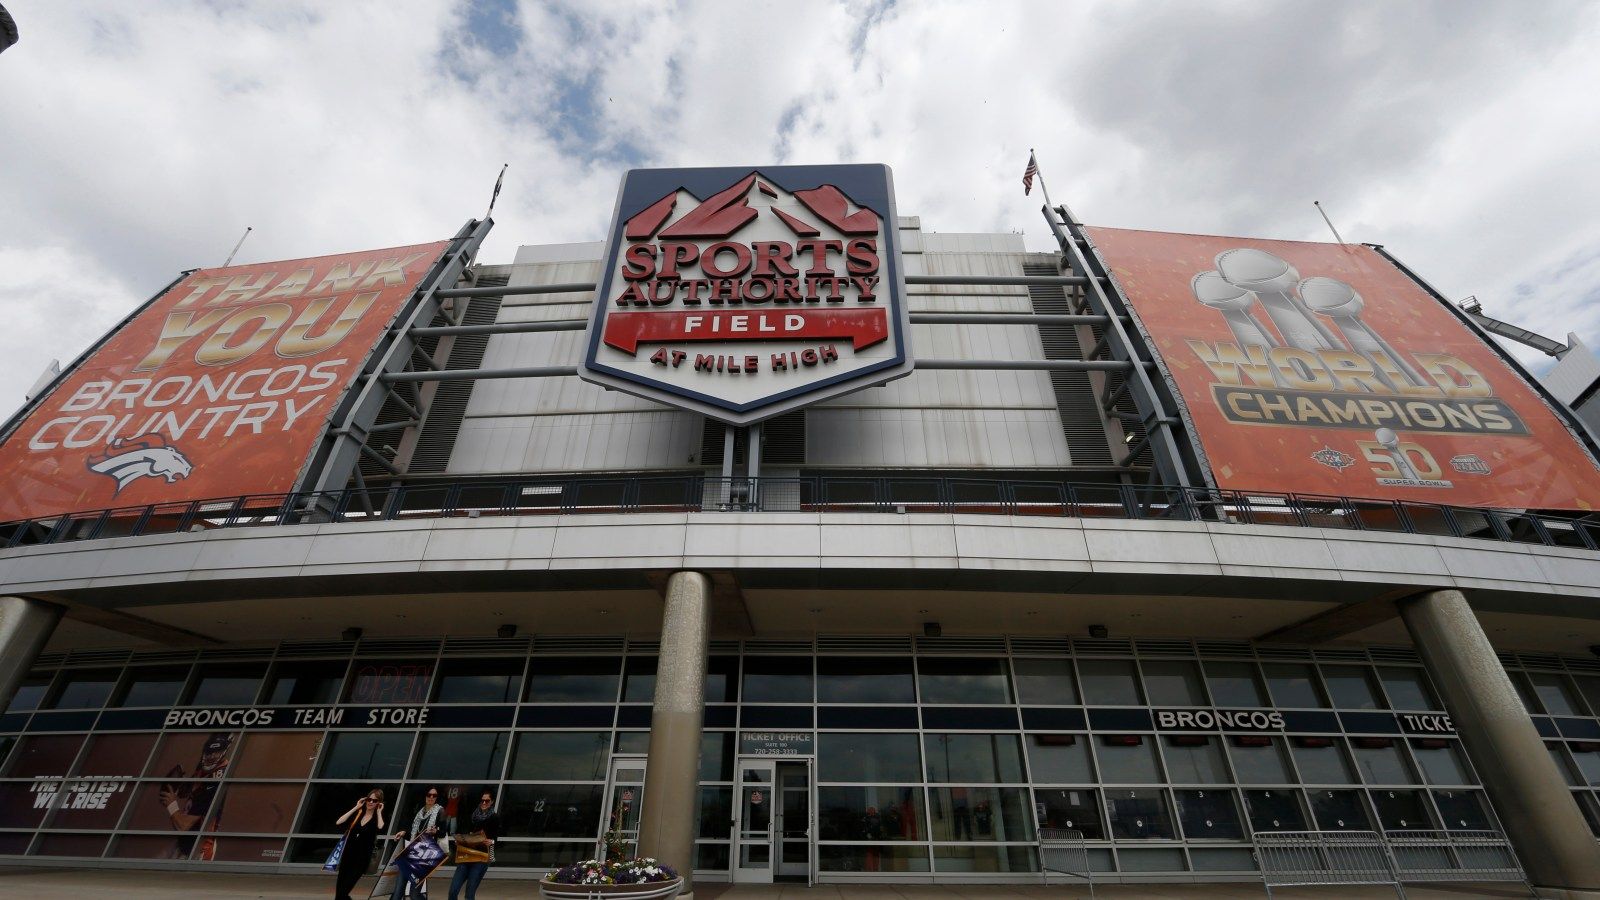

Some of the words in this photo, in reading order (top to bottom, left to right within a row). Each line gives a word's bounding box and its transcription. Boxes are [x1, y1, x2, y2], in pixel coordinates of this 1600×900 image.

[621, 238, 880, 282] SPORTS
[179, 252, 428, 309] THANK
[616, 276, 879, 306] AUTHORITY
[133, 290, 382, 374] YOU
[684, 314, 805, 333] FIELD
[650, 347, 687, 368] AT
[694, 354, 759, 373] MILE
[771, 344, 839, 371] HIGH
[1185, 339, 1494, 399] WORLD
[59, 358, 348, 412] BRONCOS
[28, 394, 326, 450] COUNTRY
[1226, 391, 1513, 430] CHAMPIONS
[1355, 440, 1443, 479] 50
[1383, 478, 1416, 486] SUPER
[164, 708, 276, 726] BRONCOS
[293, 708, 344, 725] TEAM
[367, 708, 429, 725] STORE
[1158, 710, 1286, 729] BRONCOS
[743, 732, 775, 741] TICKET
[778, 733, 811, 742] OFFICE
[30, 775, 62, 792] THE
[65, 775, 133, 793] ASTEST
[1061, 790, 1066, 798] 1
[33, 792, 71, 809] WIL
[71, 792, 112, 809] RISE
[534, 800, 545, 812] 22
